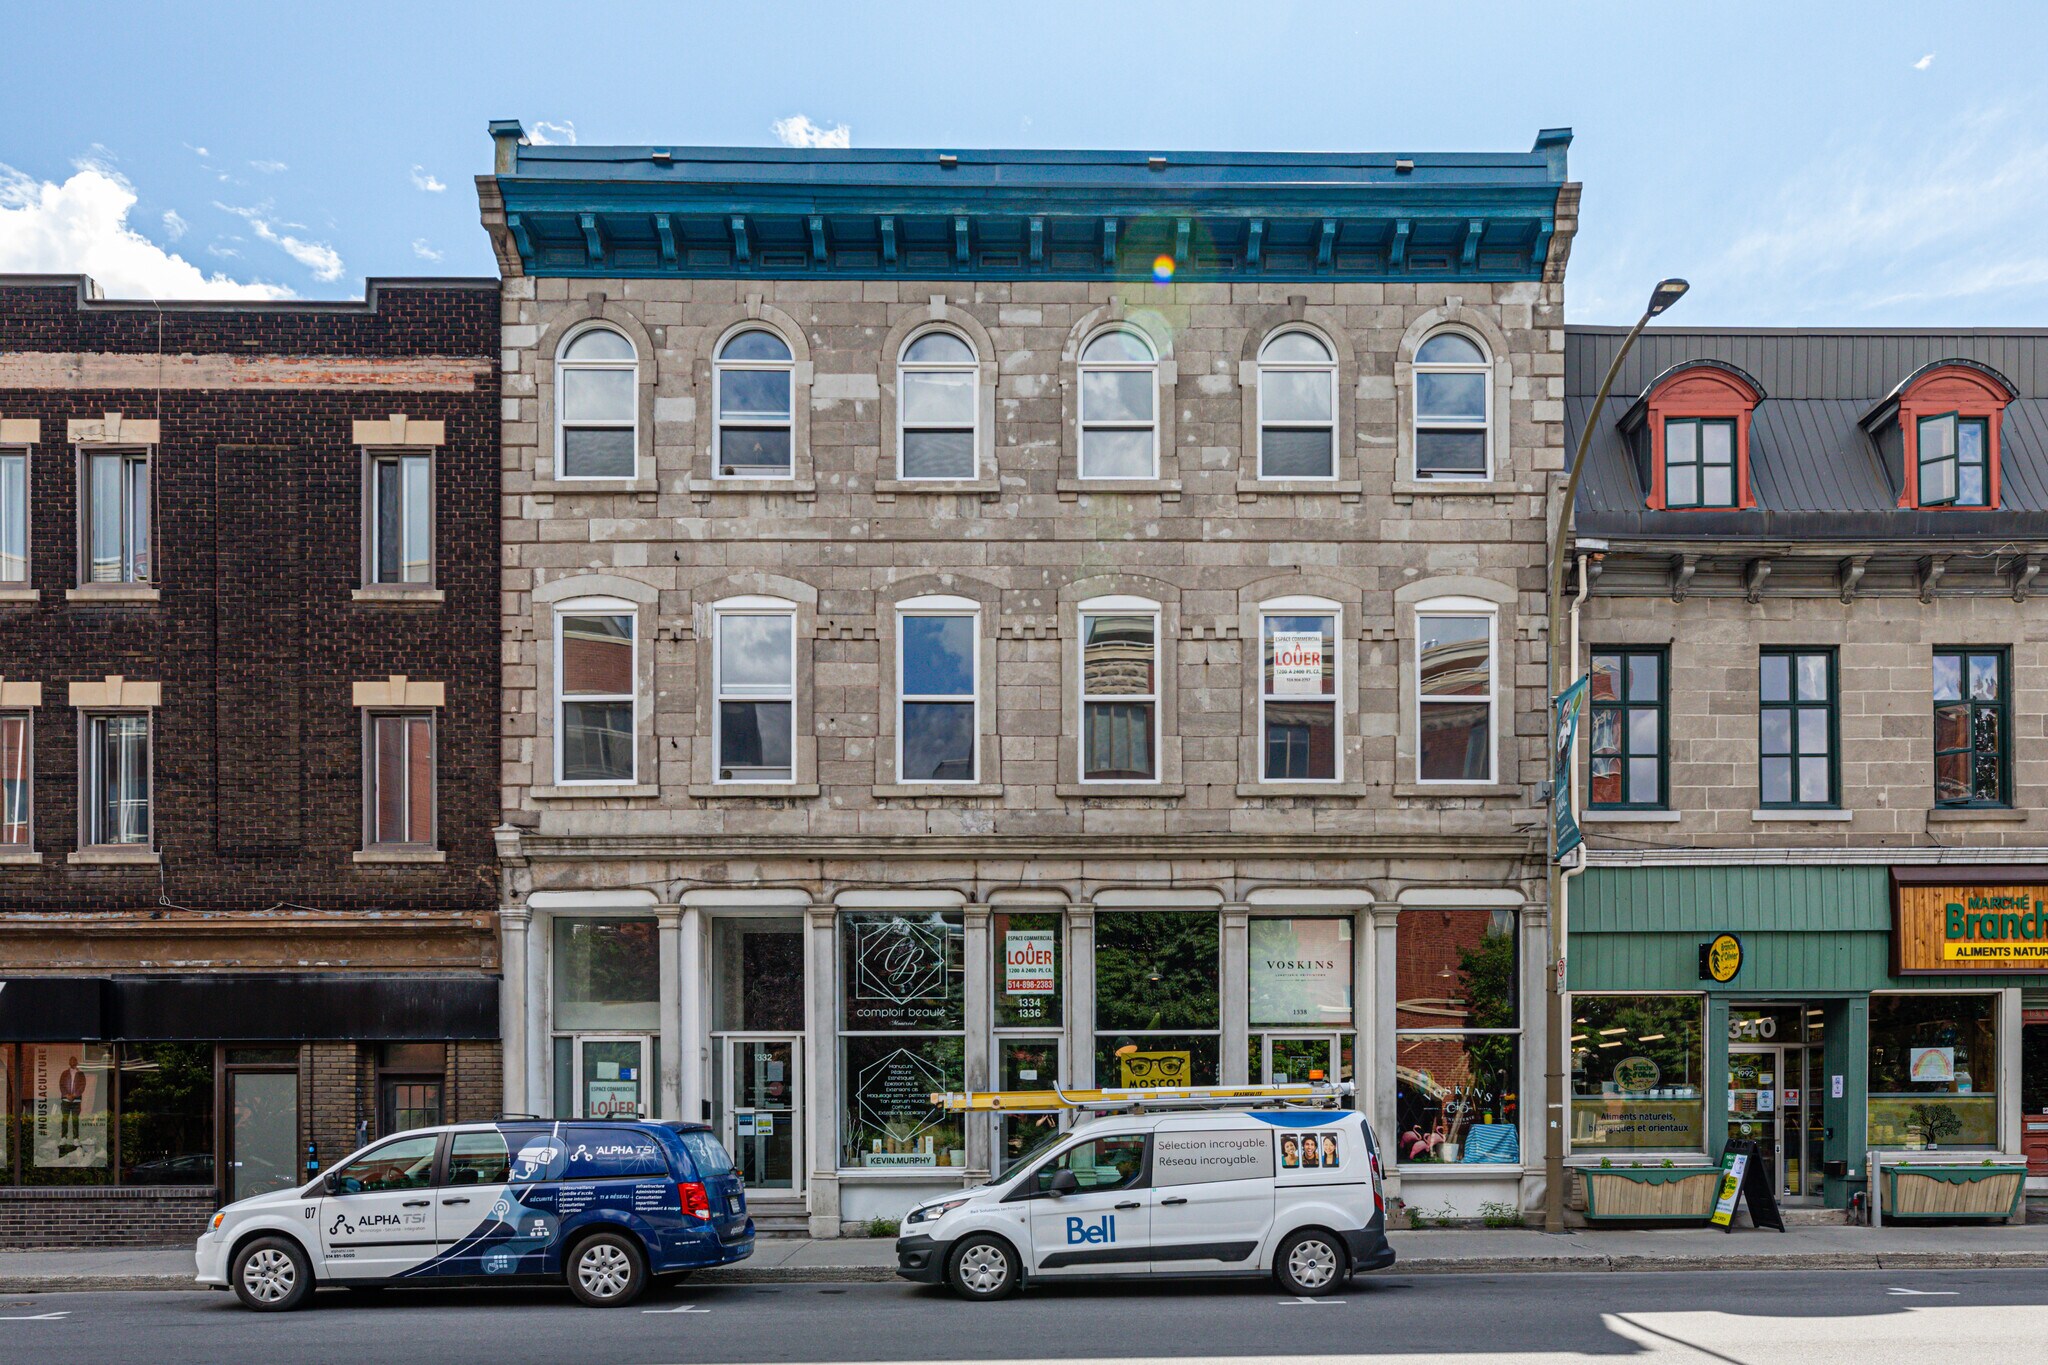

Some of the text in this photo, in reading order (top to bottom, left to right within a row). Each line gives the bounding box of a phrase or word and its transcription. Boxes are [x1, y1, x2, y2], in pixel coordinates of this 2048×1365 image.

[1295, 641, 1301, 651] À
[1275, 651, 1320, 666] LOUER
[1968, 894, 2030, 910] MARCHÉ
[1027, 941, 1034, 951] À
[1956, 947, 2048, 956] ALIMENTS NATUR
[1007, 950, 1052, 965] LOUER
[1266, 960, 1334, 970] VOSKINS
[1008, 980, 1053, 989] 514-898-2383
[1018, 998, 1041, 1007] 1334
[856, 1006, 946, 1018] comptoir beauté
[1018, 1008, 1041, 1018] 1336
[754, 1053, 772, 1062] 1332
[1128, 1078, 1182, 1088] MOSCOT
[38, 1048, 48, 1136] #NOUSLACULTURE
[610, 1092, 616, 1102] À
[1423, 1085, 1493, 1103] VOSKINS
[591, 1101, 635, 1116] LOUER
[1601, 1112, 1676, 1122] Aliments naturels,
[1637, 1124, 1646, 1132] et
[1648, 1124, 1689, 1132] orientaux
[1158, 1137, 1268, 1151] Sélection incroyable.
[596, 1146, 634, 1155] ALPHA
[870, 1157, 932, 1165] KEVIN.MURPHY
[1159, 1153, 1259, 1168] Réseau incroyable.
[530, 1194, 554, 1203] SÉCURITÉ
[305, 1206, 316, 1219] 07
[358, 1214, 401, 1226] ALPHA
[1066, 1214, 1116, 1245] Bell
